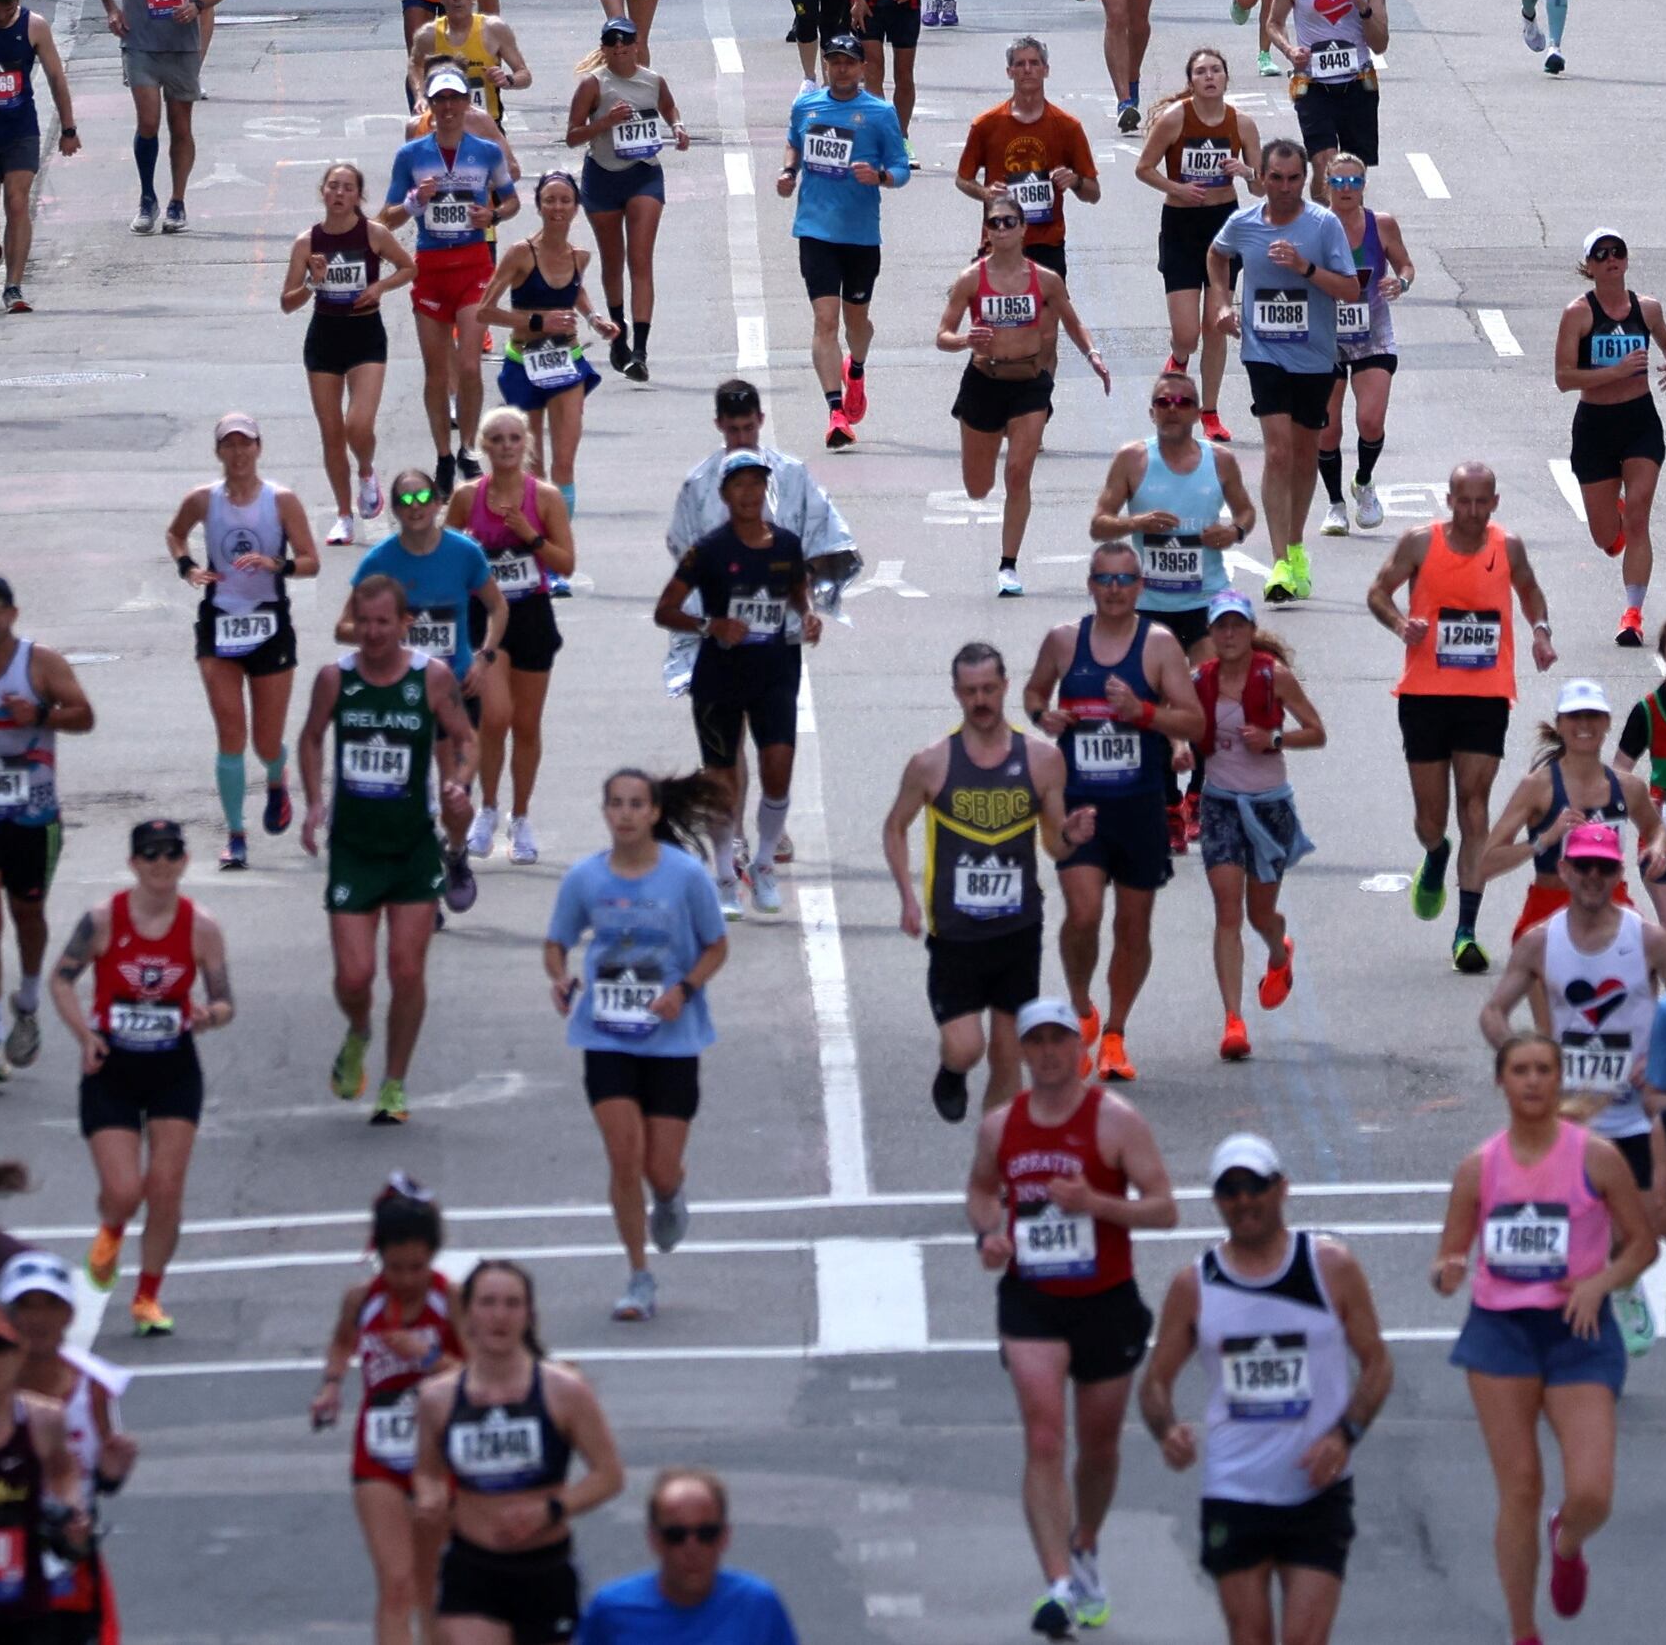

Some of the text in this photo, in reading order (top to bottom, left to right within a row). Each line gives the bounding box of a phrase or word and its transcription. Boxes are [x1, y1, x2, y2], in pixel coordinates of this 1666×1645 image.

[1320, 51, 1351, 69] 8448
[618, 120, 658, 141] 13713
[809, 139, 846, 159] 10338
[432, 206, 466, 224] 9988
[327, 267, 360, 284] 4087
[987, 296, 1030, 315] 11953
[1259, 306, 1303, 325] 10388
[1337, 307, 1363, 327] 591
[1150, 553, 1197, 572] 13958
[341, 713, 420, 730] IRELAND
[1080, 738, 1131, 761] 11034
[952, 788, 1029, 827] SBRC
[967, 873, 1012, 897] 8877
[1567, 1056, 1624, 1080] 11747
[375, 1414, 414, 1441] 147
